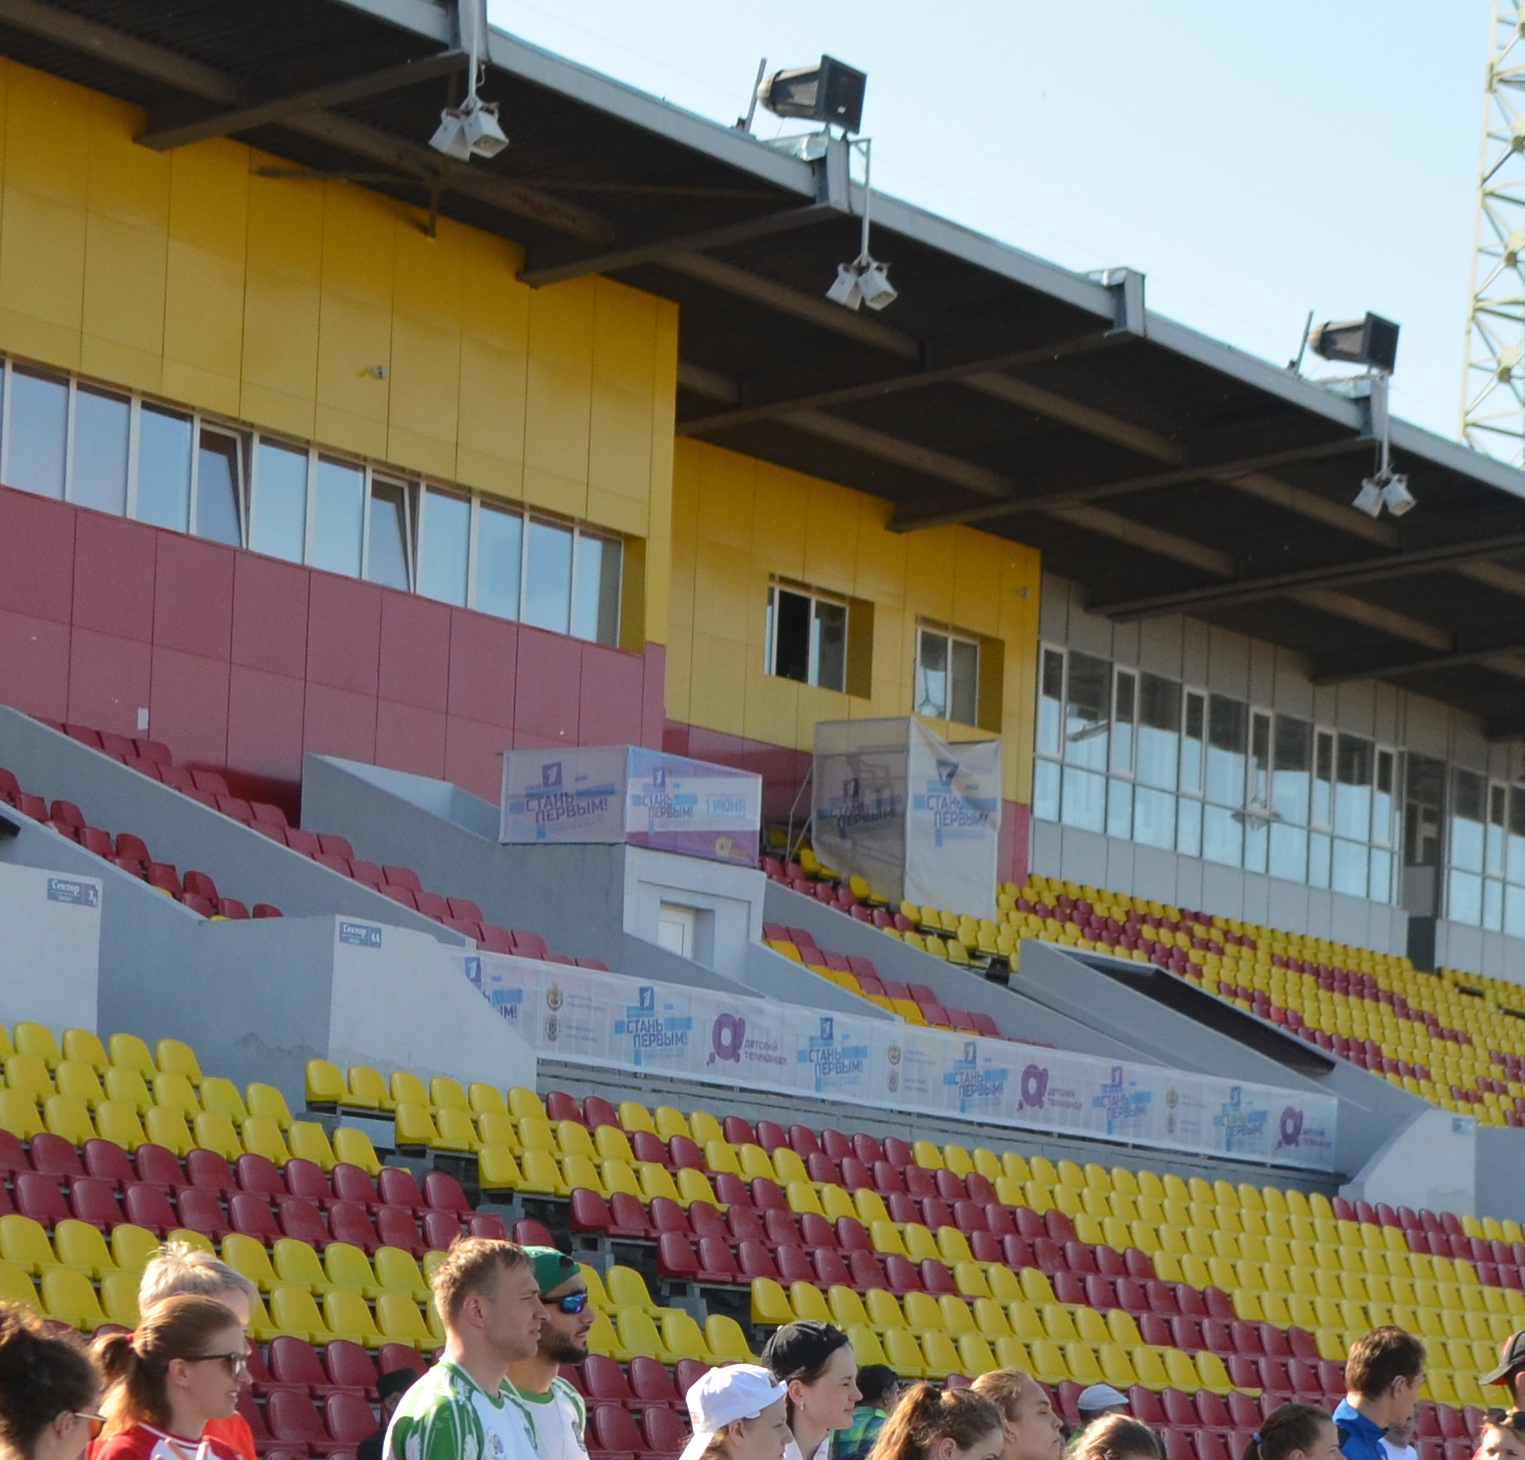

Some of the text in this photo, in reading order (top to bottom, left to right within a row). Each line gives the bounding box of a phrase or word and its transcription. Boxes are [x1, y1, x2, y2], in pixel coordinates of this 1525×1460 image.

[525, 791, 575, 813] СТАНЬ
[535, 797, 608, 824] ПЕРВЫМ!
[648, 805, 694, 819] ПЕРВЫМ!
[626, 1019, 663, 1035] СТАНЬ
[632, 1032, 688, 1049] ПЕРВЫМ!
[744, 1038, 778, 1052] детский
[744, 1050, 787, 1065] телеканал
[808, 1048, 842, 1063] СТАНЬ
[814, 1060, 864, 1076] ПЕРВЫМ!
[953, 1072, 984, 1086] СТАНЬ
[958, 1082, 1004, 1098] ПЕРВЫМ!
